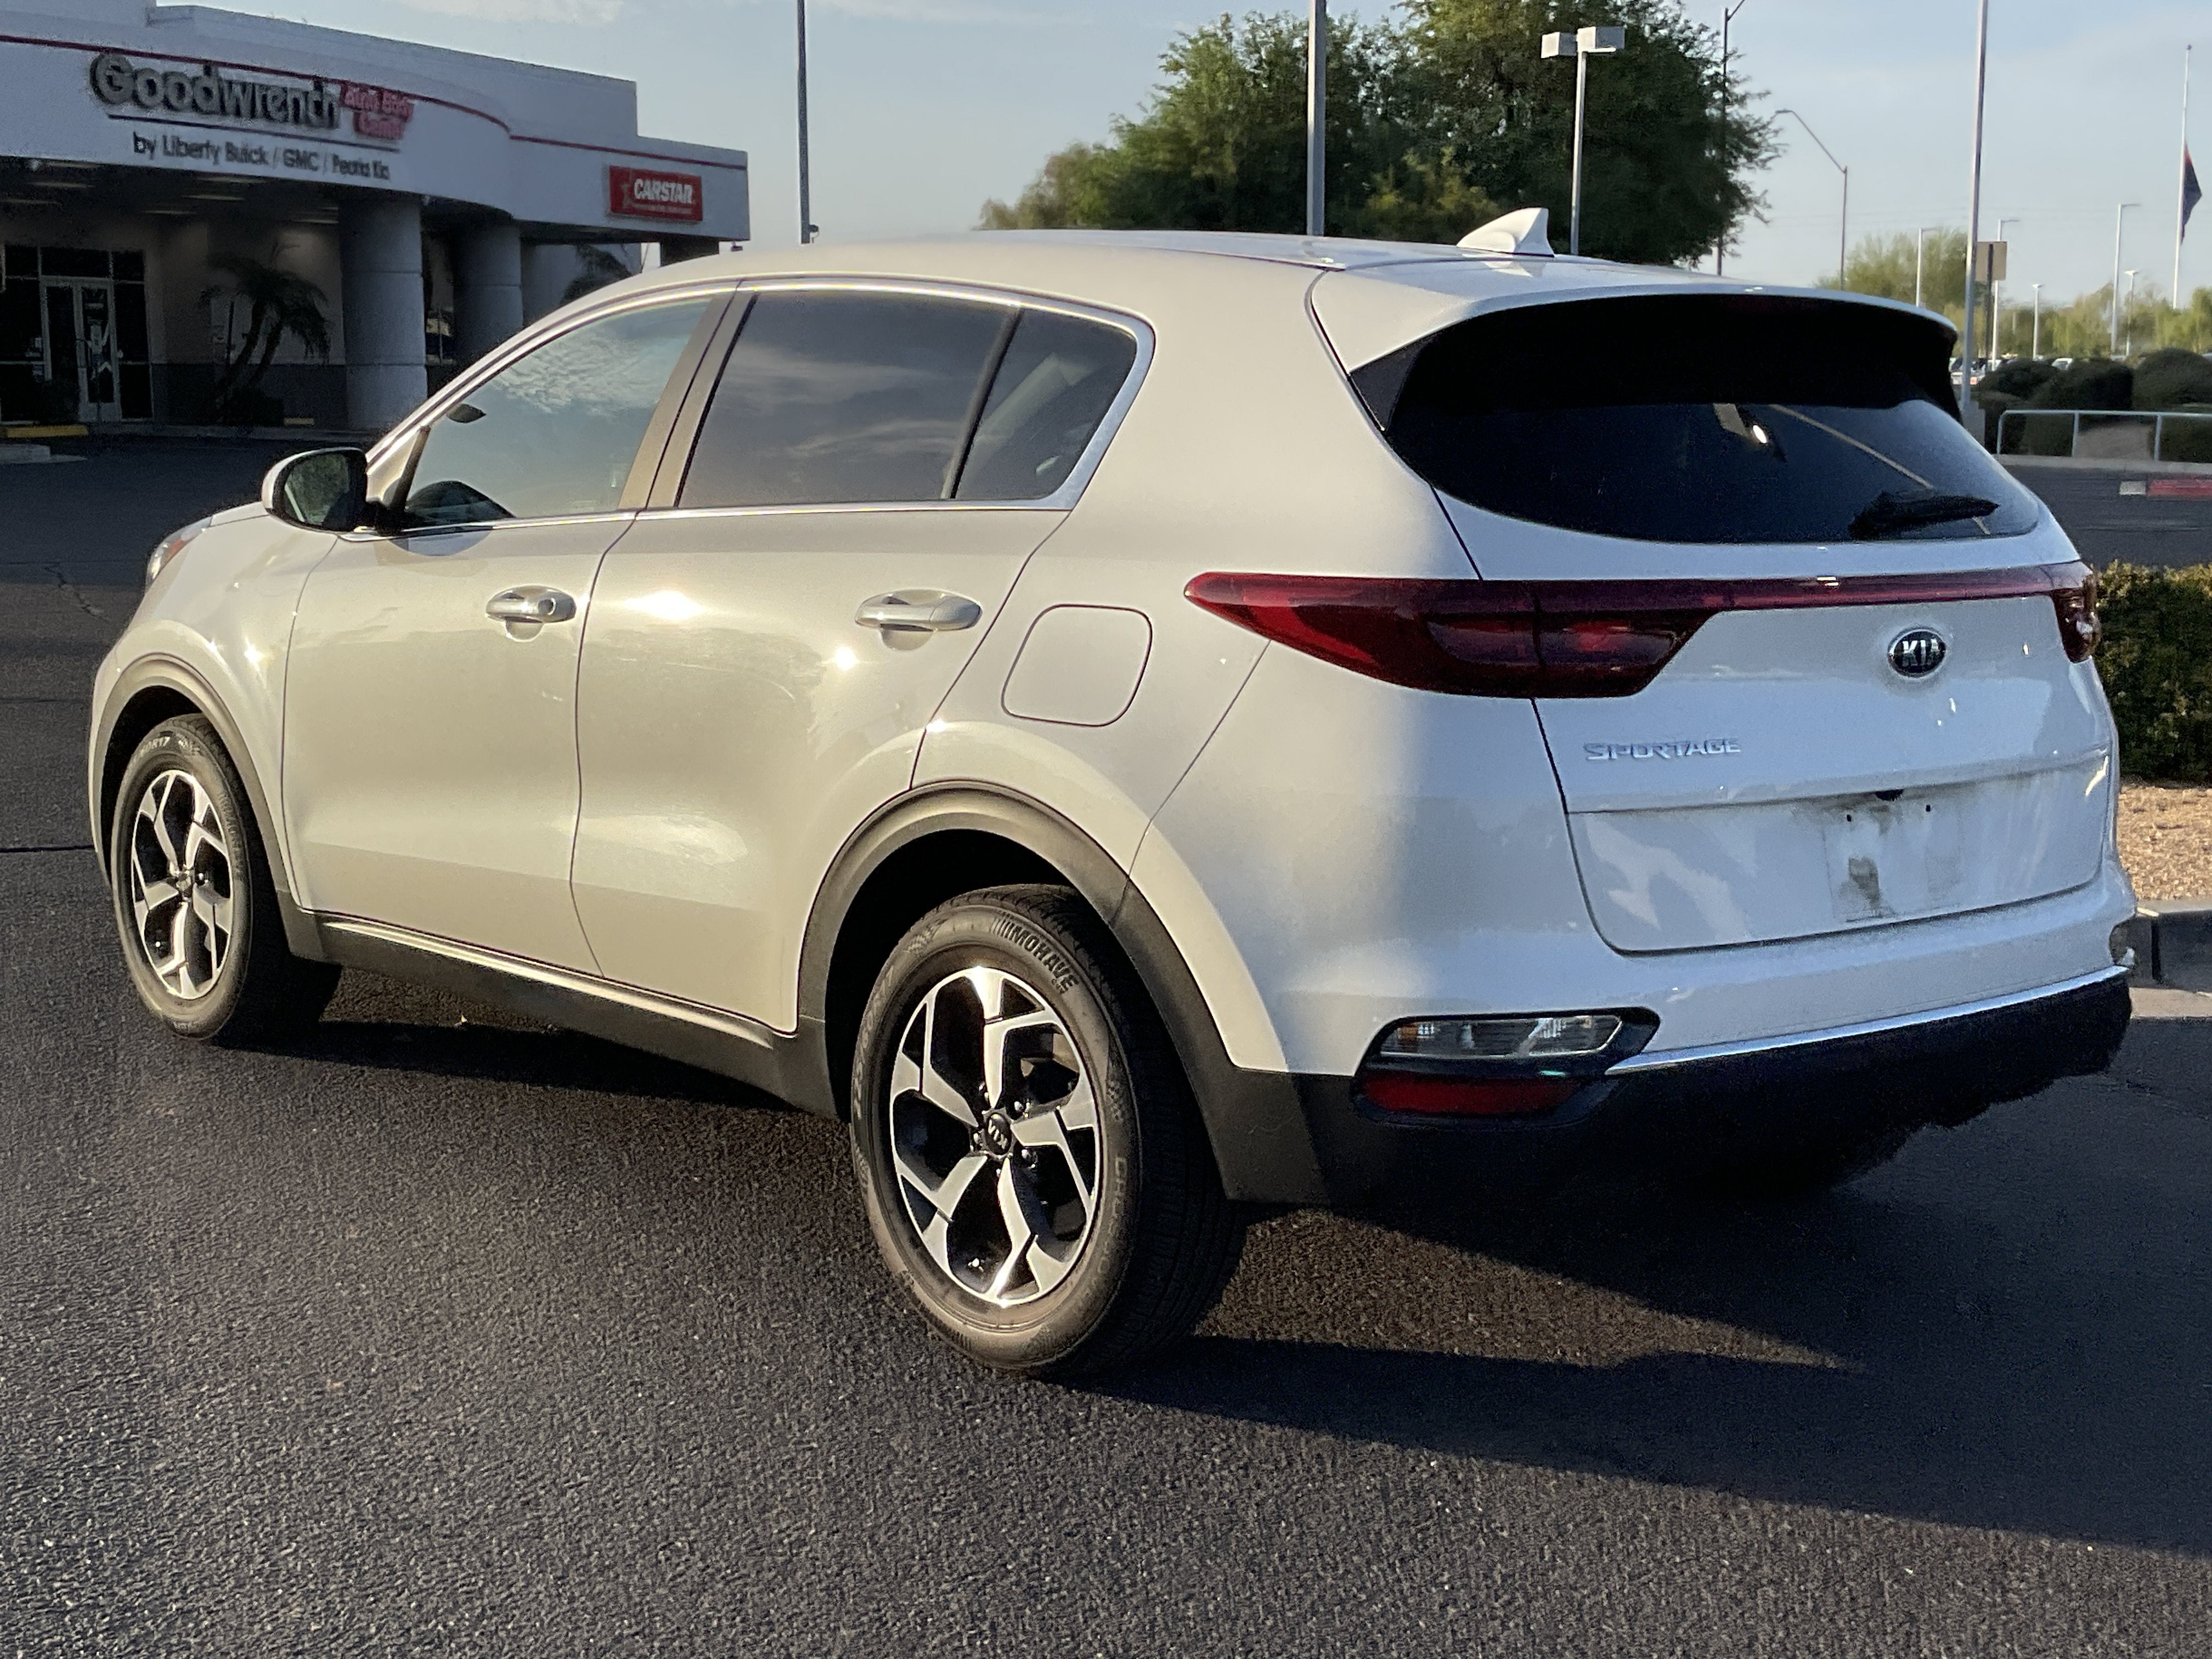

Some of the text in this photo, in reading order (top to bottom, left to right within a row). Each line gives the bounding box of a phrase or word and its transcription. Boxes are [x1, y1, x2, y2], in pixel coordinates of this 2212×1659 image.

[89, 54, 341, 129] Goodwrench
[133, 131, 156, 161] by
[162, 135, 221, 166] Liberty
[225, 141, 269, 165] Buick
[283, 148, 319, 171] GMC
[634, 178, 693, 204] CARSTAR
[1902, 639, 1940, 667] KIA
[1583, 738, 1741, 761] SPORTAGE
[1011, 924, 1079, 988] MOHAVE
